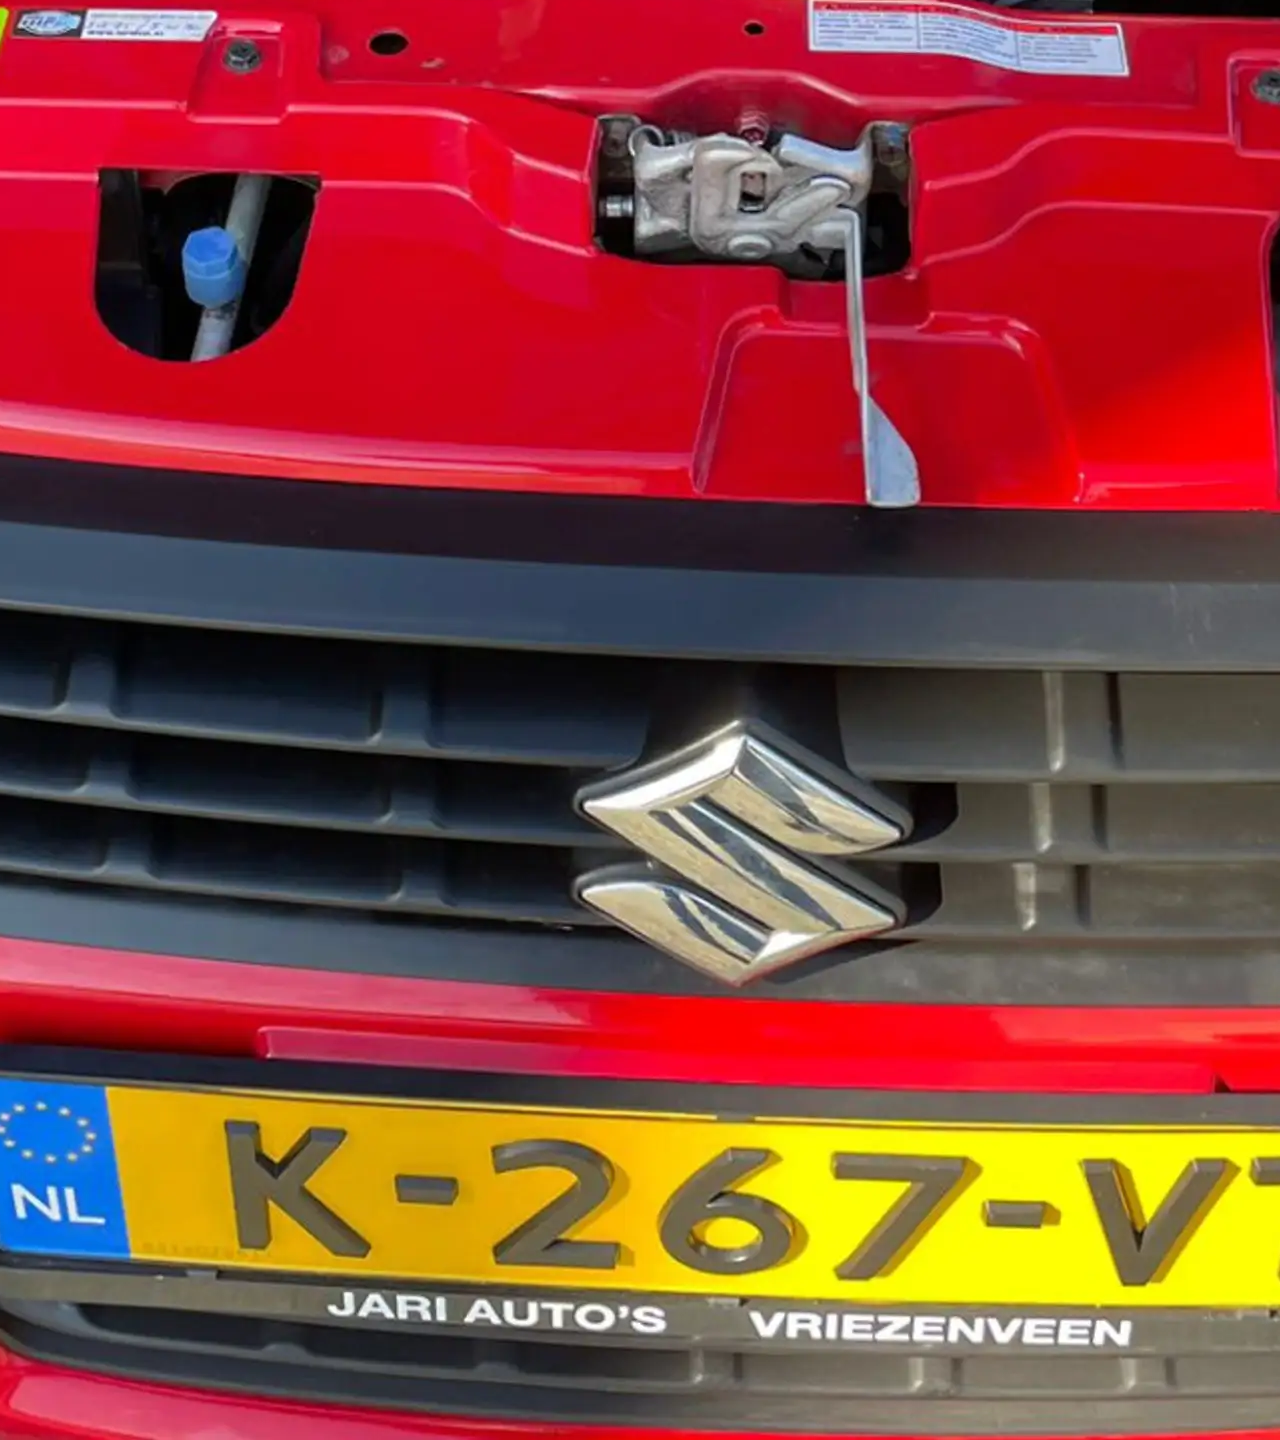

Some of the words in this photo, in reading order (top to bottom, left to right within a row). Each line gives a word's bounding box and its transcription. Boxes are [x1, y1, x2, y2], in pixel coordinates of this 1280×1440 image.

[11, 1182, 107, 1226] NL
[327, 1291, 448, 1323] JARI
[464, 1298, 667, 1334] AUTO'S
[749, 1310, 1133, 1347] VRIEZENVEEN
